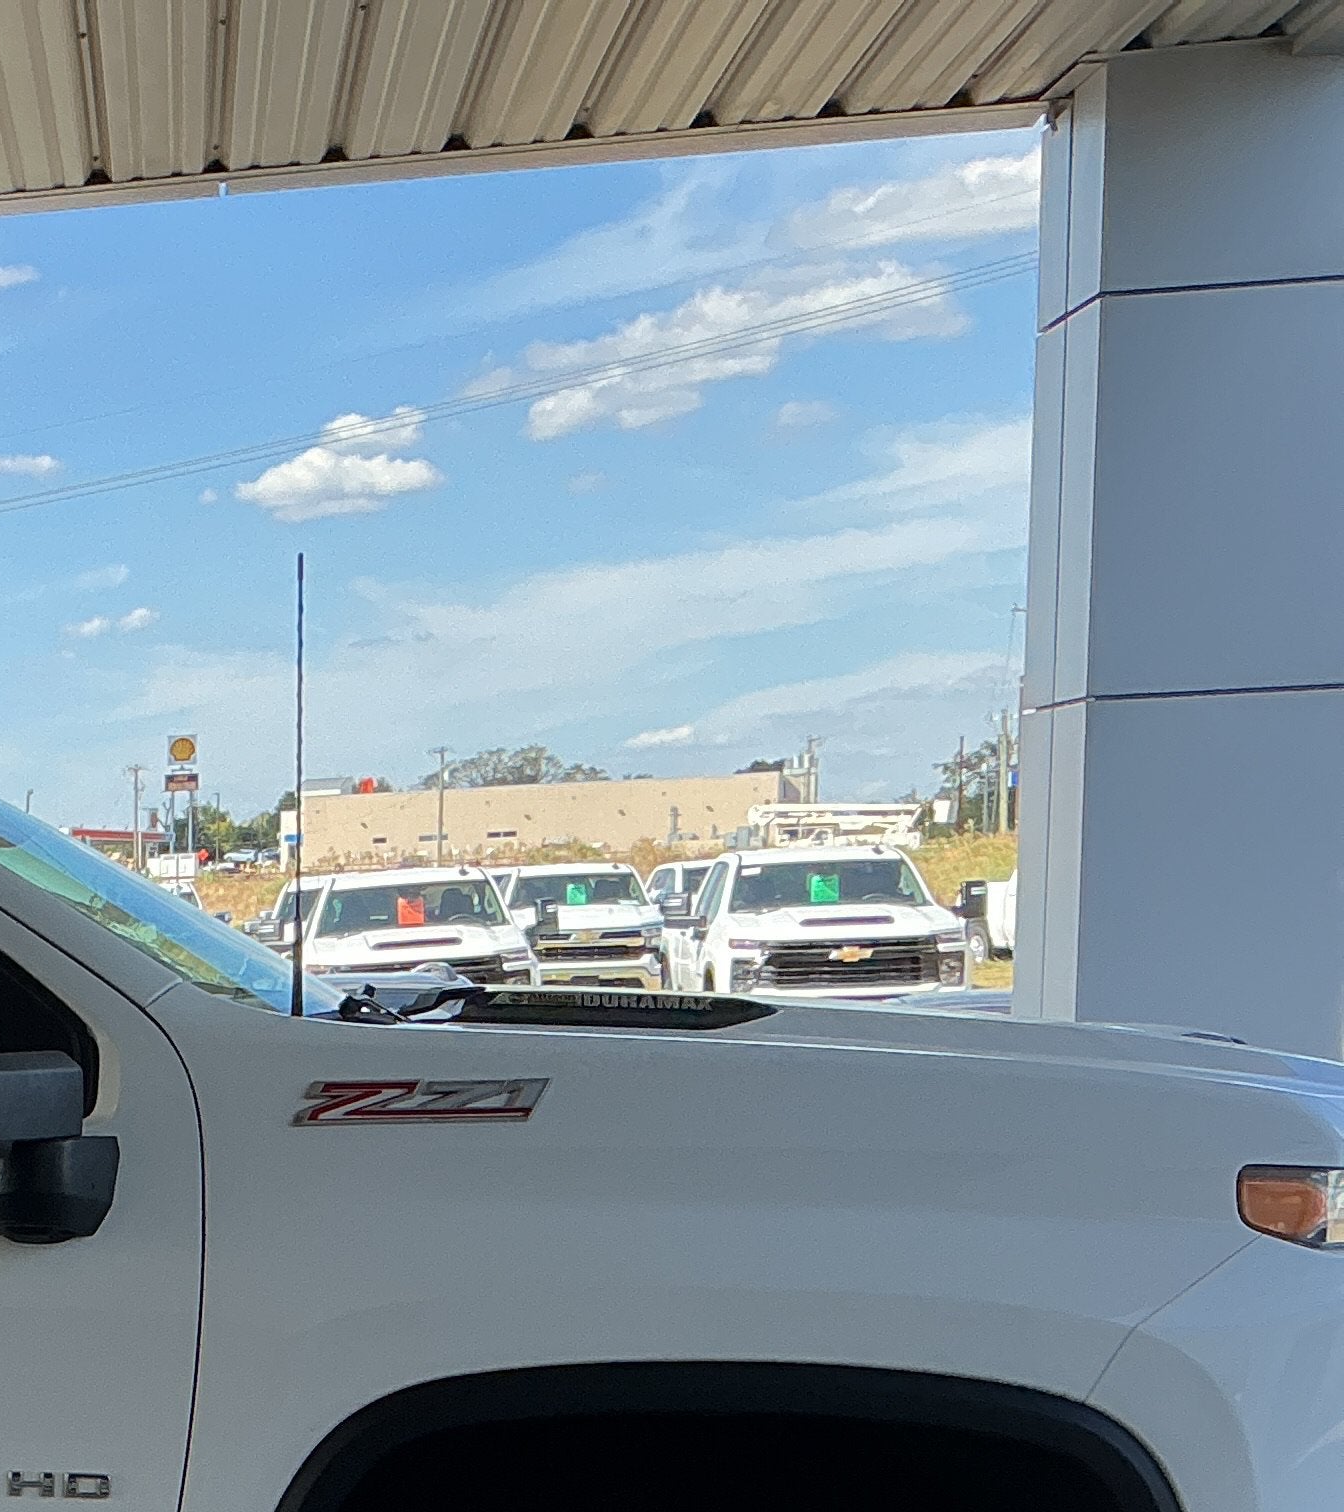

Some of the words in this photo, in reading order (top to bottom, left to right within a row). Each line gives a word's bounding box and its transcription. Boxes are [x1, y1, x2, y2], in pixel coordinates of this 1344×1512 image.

[584, 993, 713, 1011] DURAMAX
[289, 1077, 552, 1127] Z71
[7, 1470, 112, 1499] HD
